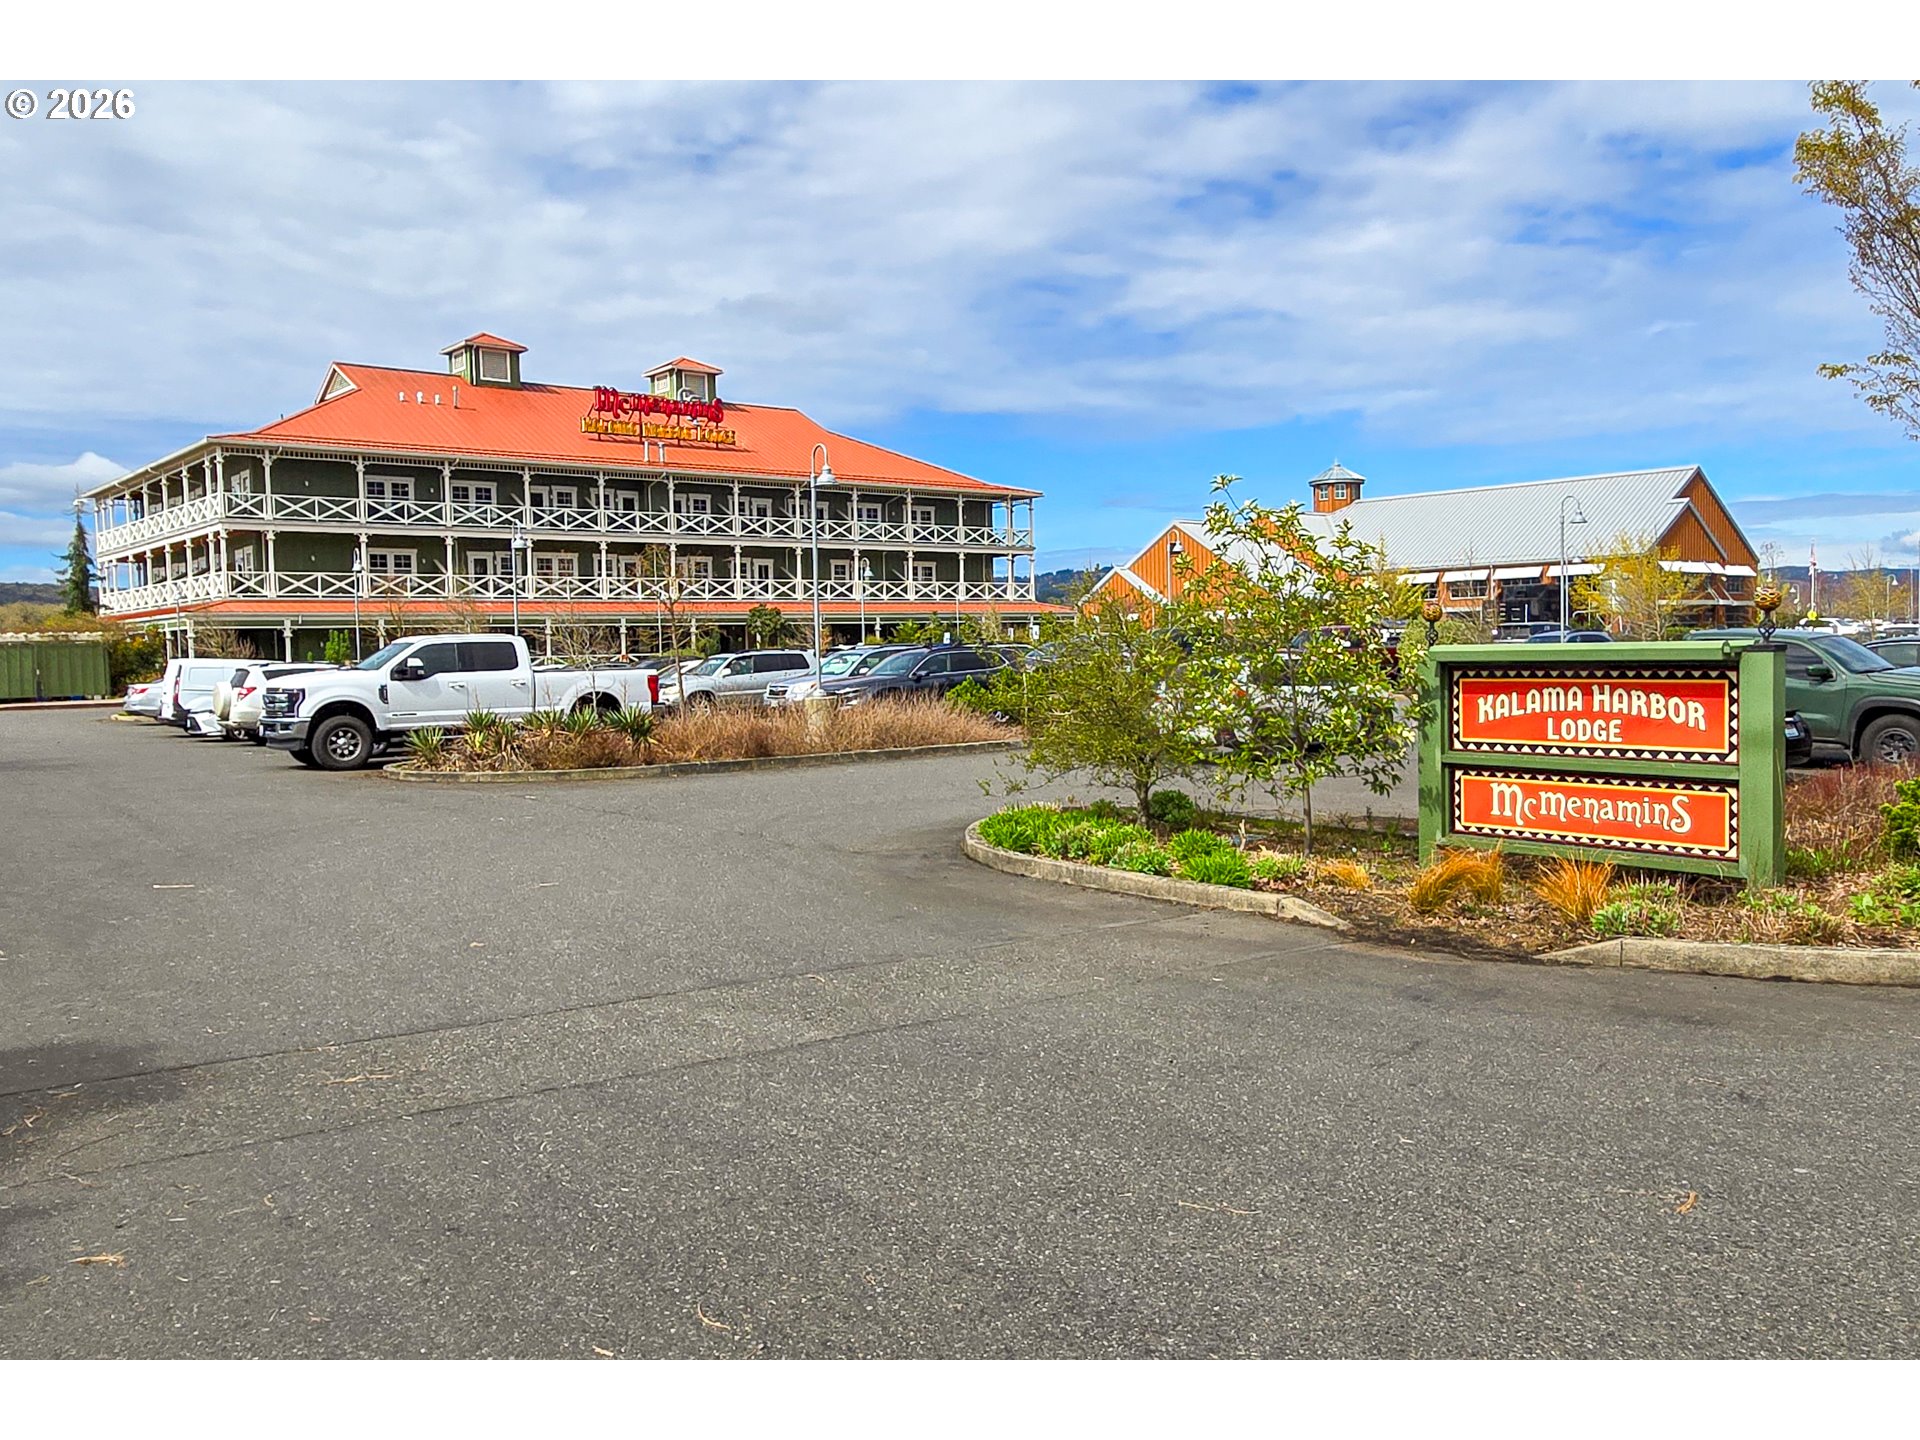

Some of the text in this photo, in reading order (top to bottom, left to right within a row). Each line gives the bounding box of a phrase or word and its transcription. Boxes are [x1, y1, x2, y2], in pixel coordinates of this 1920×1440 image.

[1477, 684, 1707, 731] KALAMA HARBOR
[1547, 717, 1623, 743] LODGE
